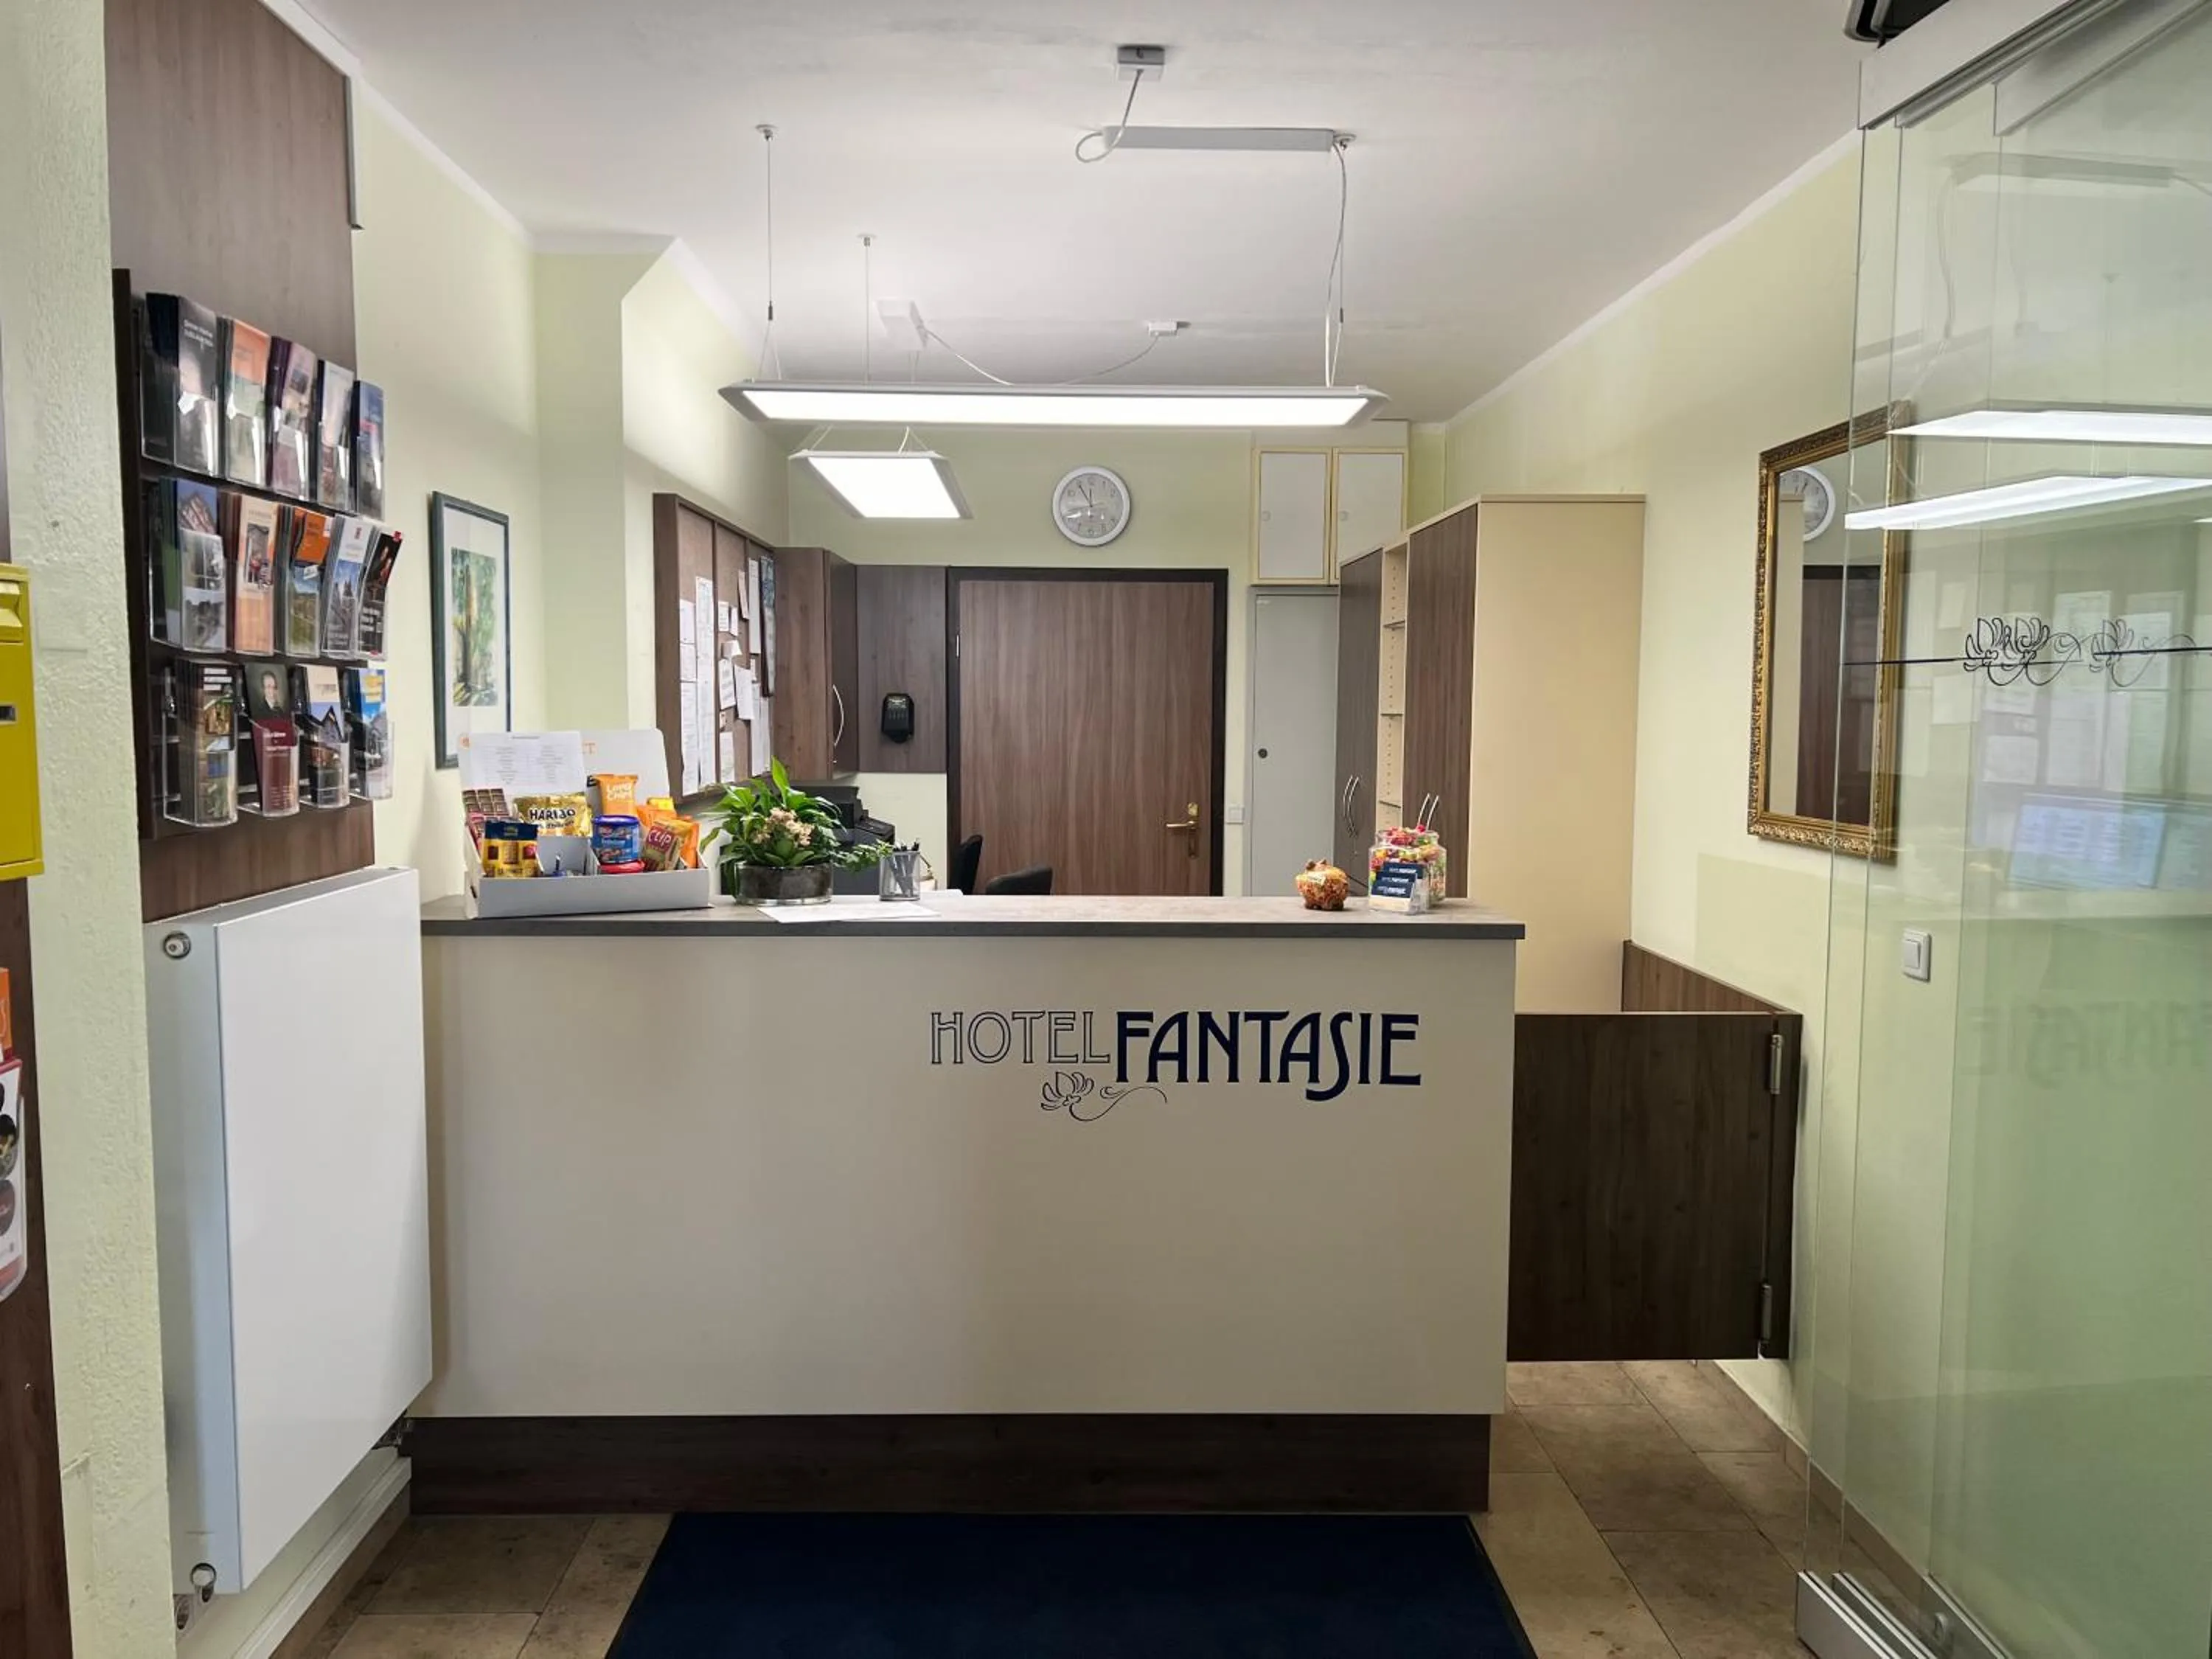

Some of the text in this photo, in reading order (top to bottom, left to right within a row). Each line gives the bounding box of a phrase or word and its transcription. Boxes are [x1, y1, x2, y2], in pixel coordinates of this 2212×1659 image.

[529, 808, 577, 821] HARIBO
[648, 829, 672, 847] CLIP
[931, 1010, 1422, 1102] HOTEL FANTASIE
